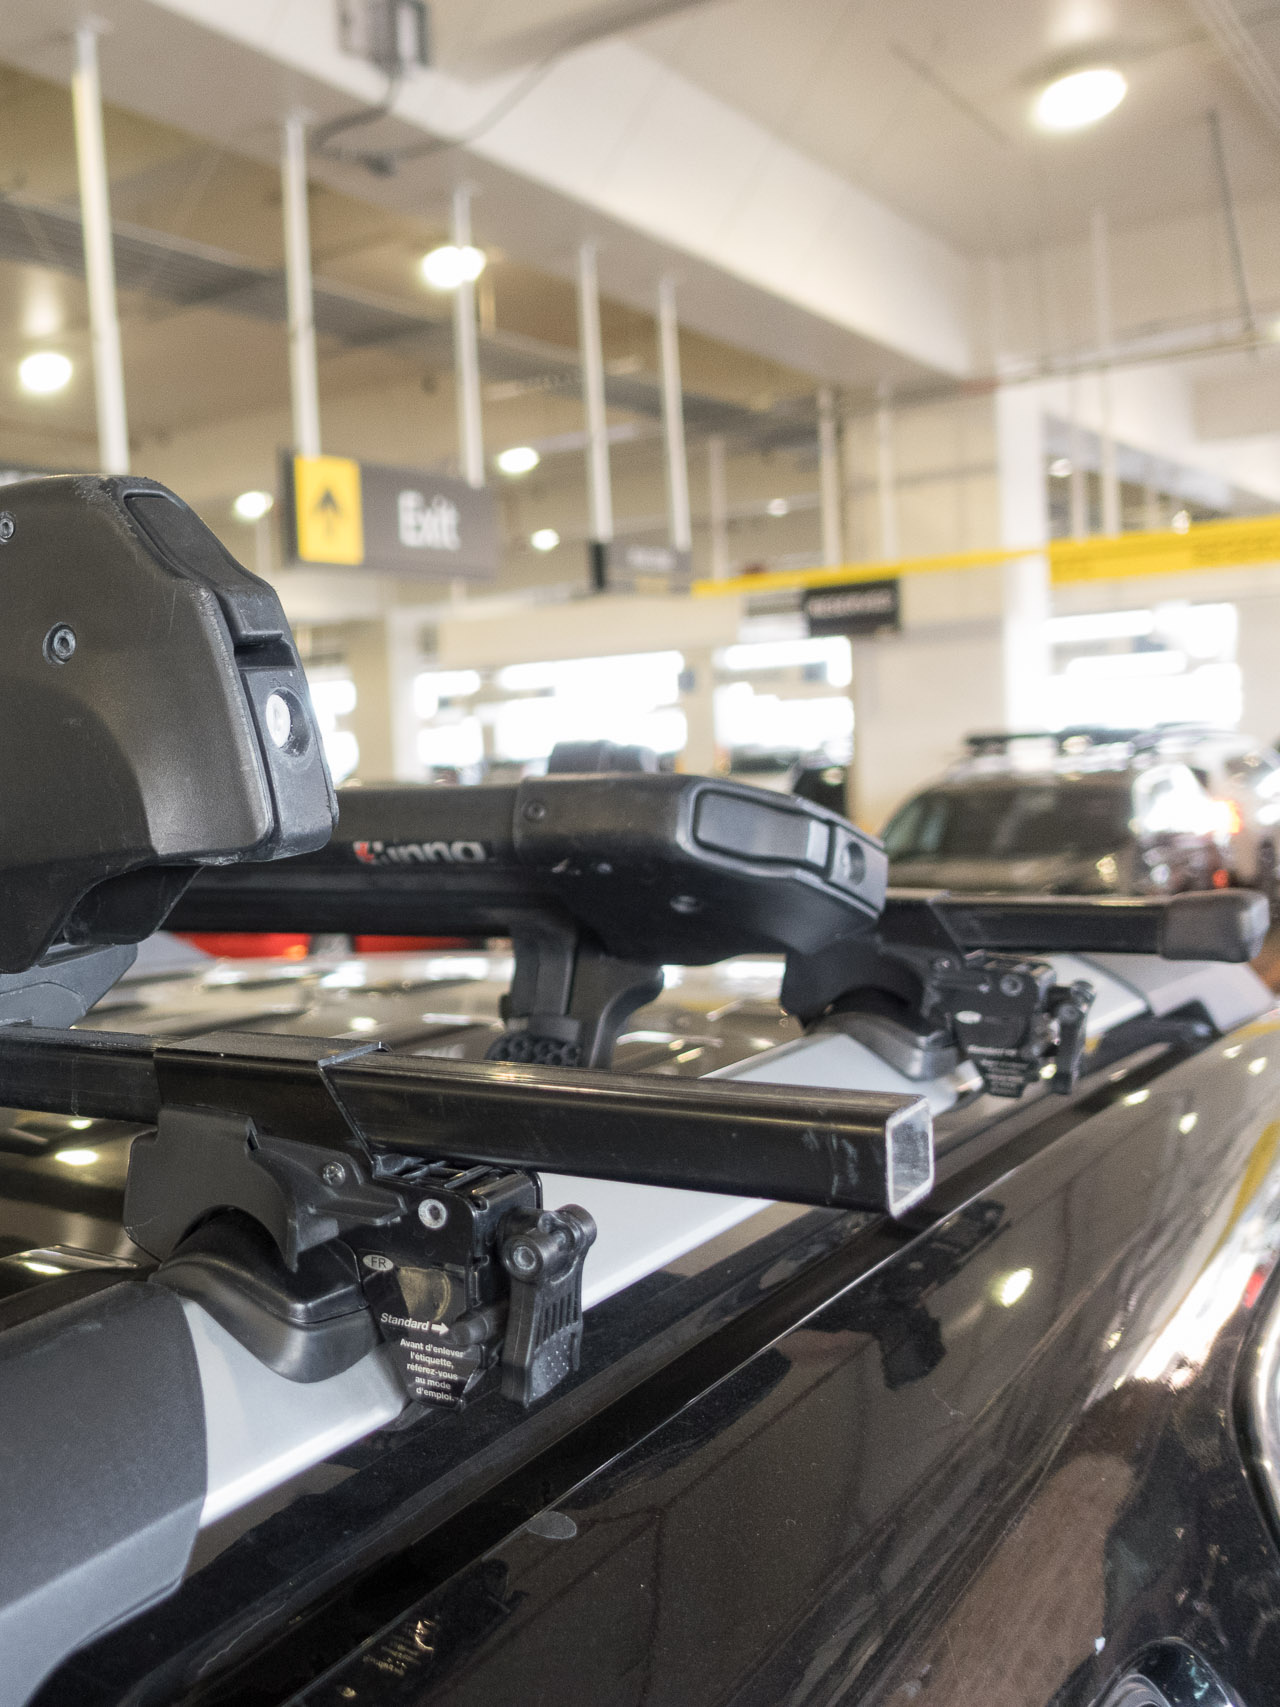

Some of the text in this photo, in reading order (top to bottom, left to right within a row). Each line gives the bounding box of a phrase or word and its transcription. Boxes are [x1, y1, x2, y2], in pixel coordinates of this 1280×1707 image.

[398, 490, 460, 551] Exit
[371, 1256, 387, 1269] FR
[380, 1312, 430, 1331] Standard
[400, 1338, 464, 1358] Avant d'enlever
[415, 1376, 451, 1390] au mode
[416, 1387, 455, 1401] d'emploi.
